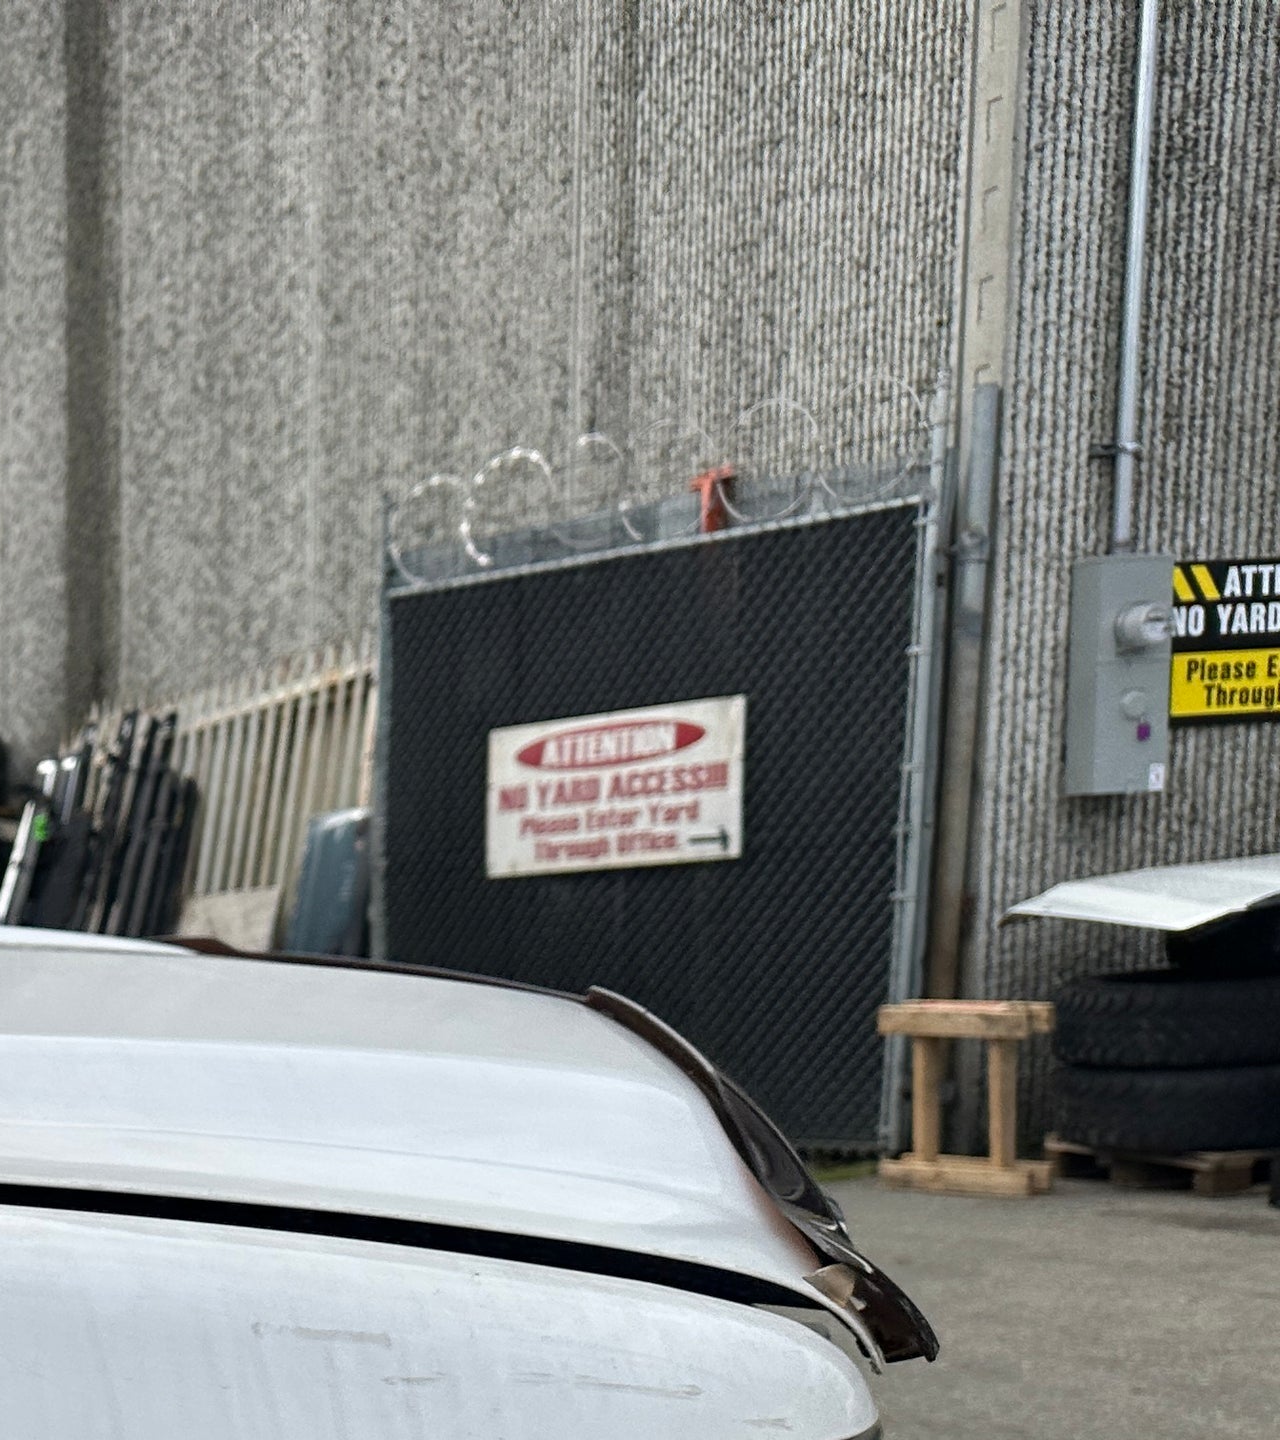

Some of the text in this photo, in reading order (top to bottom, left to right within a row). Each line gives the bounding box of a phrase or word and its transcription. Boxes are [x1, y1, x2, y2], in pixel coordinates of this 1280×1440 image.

[1172, 601, 1280, 637] NO YARD
[1186, 658, 1256, 683] Please
[1204, 681, 1280, 708] Throug
[537, 776, 601, 808] YARD
